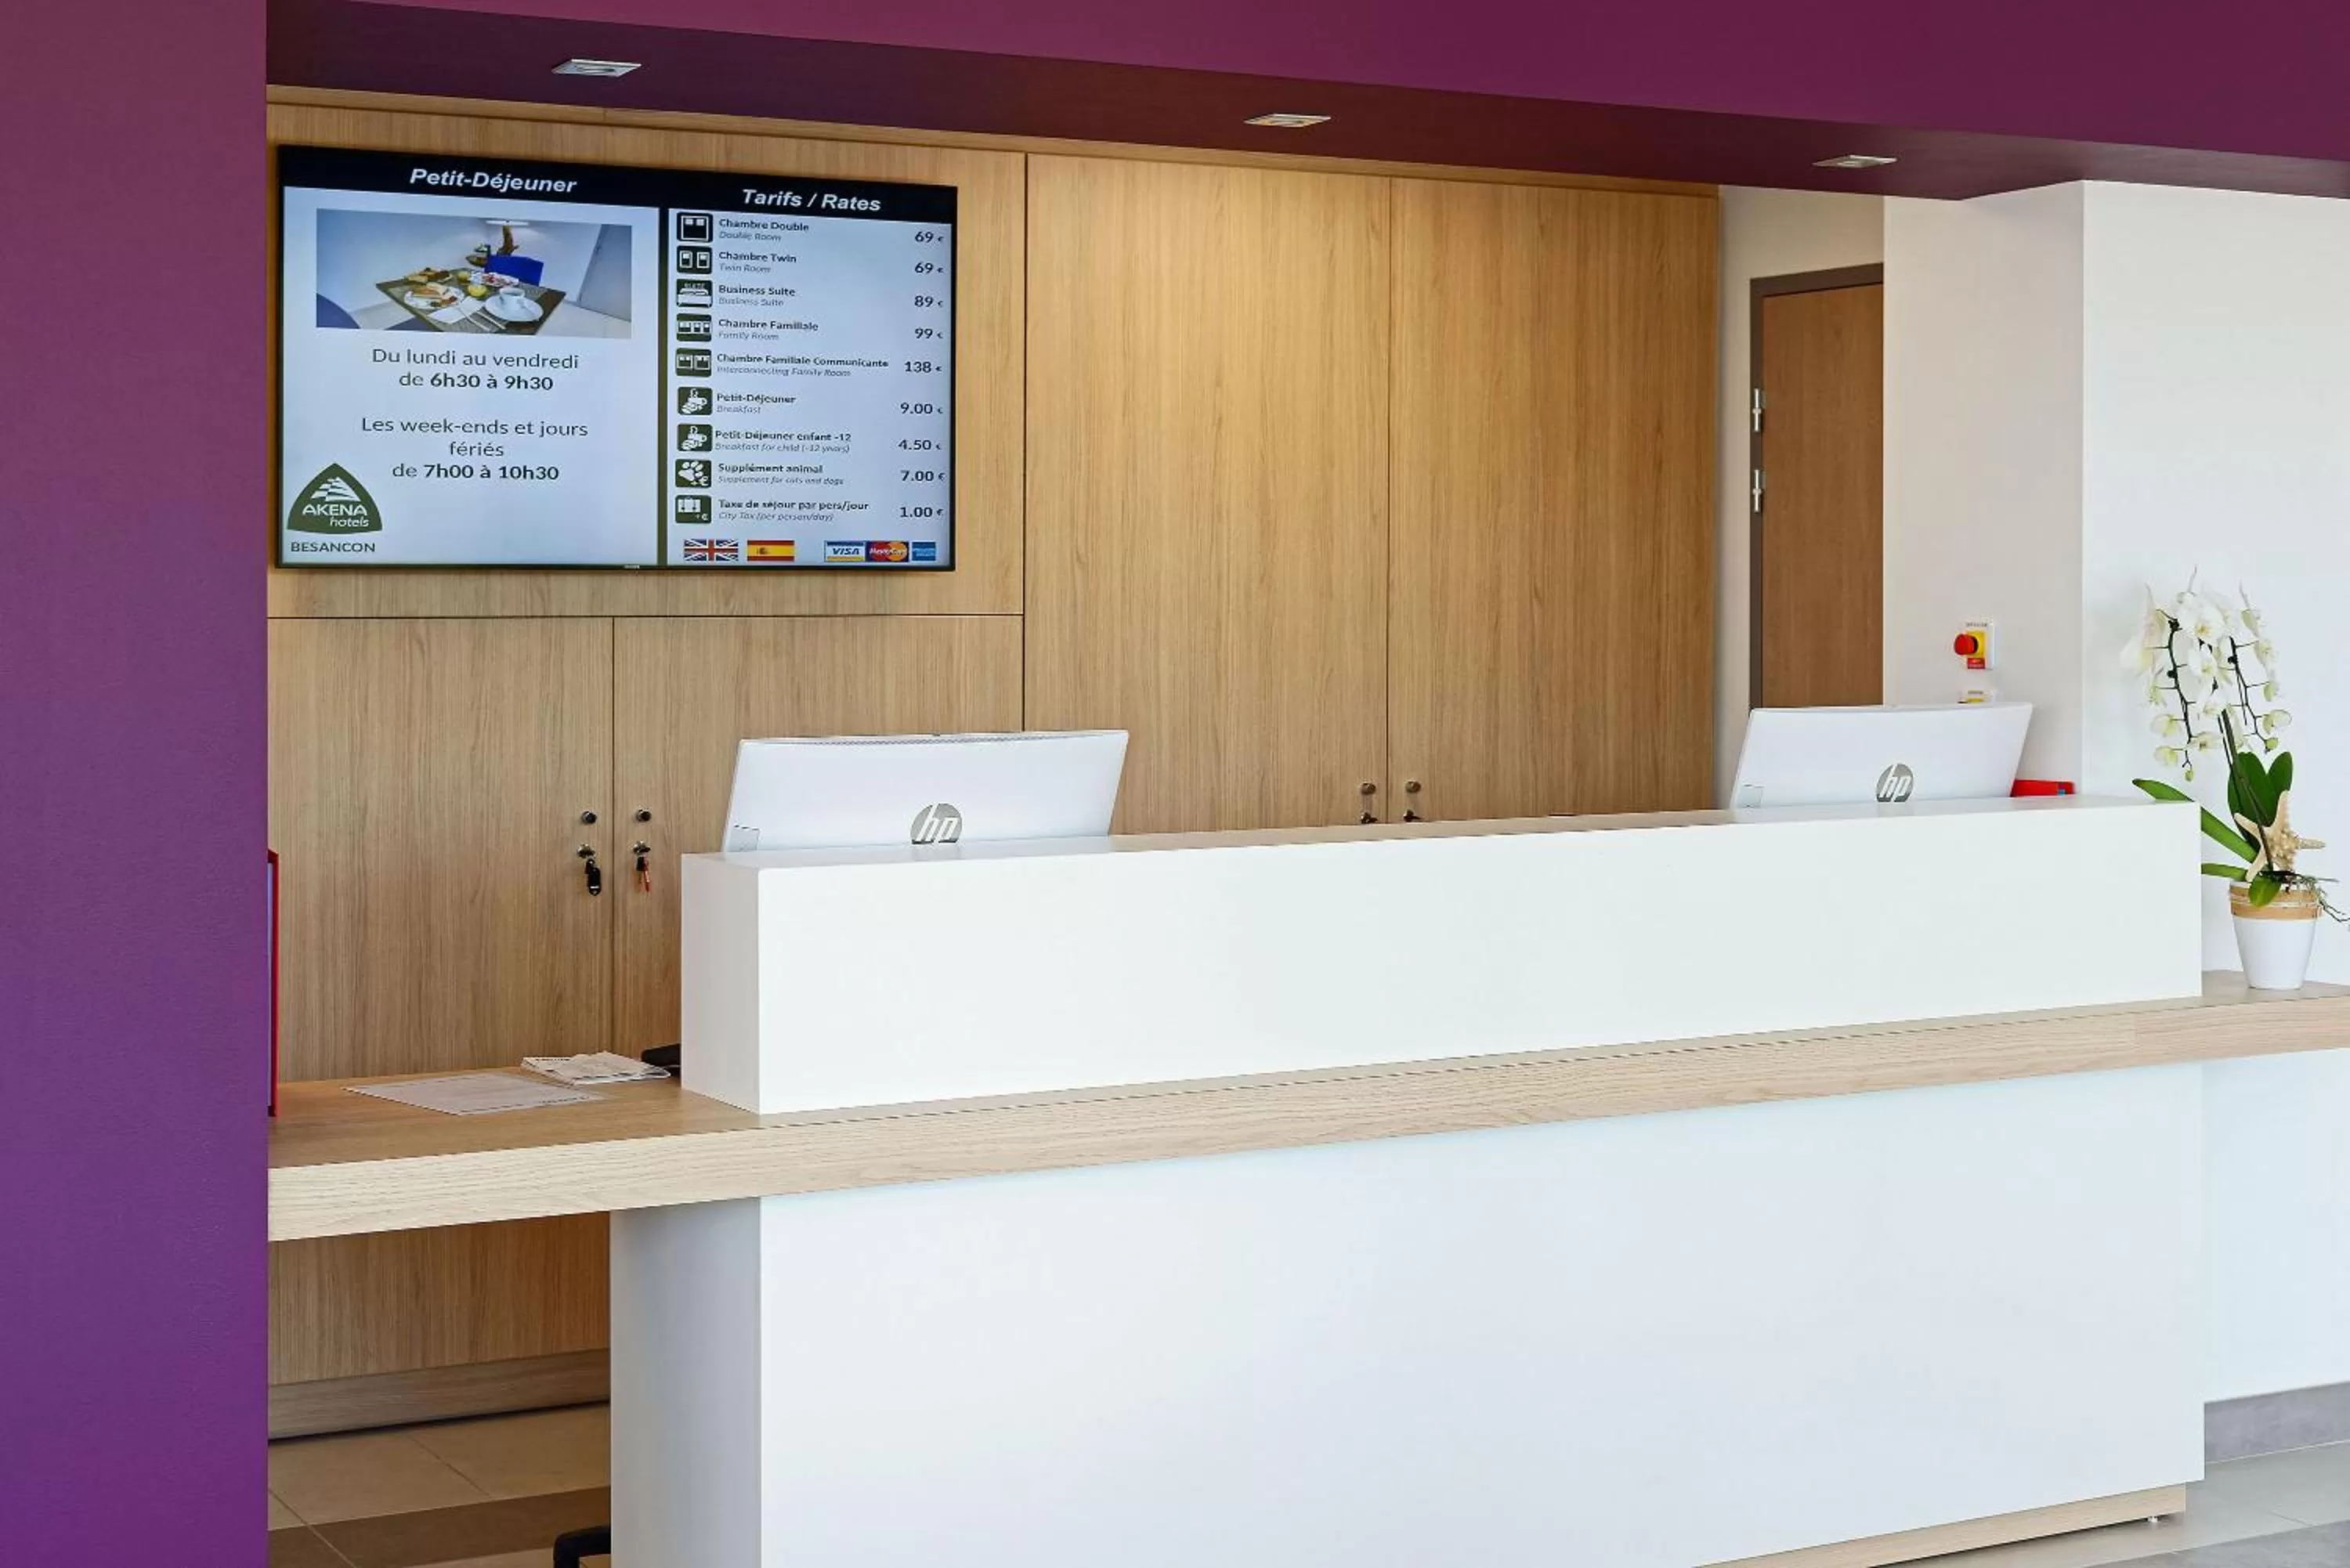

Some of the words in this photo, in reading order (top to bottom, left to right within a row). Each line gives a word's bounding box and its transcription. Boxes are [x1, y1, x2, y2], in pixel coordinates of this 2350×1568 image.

[410, 168, 577, 194] Petit-Déjeuner
[742, 189, 803, 207] Tarifs
[808, 193, 817, 207] /
[821, 193, 881, 211] Rates
[719, 219, 768, 229] Chambre
[770, 221, 809, 232] Double
[719, 231, 751, 240] Double
[754, 233, 781, 241] Room
[914, 232, 933, 243] 69
[719, 251, 768, 262] Chambre
[770, 254, 797, 263] Twin
[743, 265, 771, 273] Room
[914, 262, 933, 273] 69
[719, 285, 765, 295] Business
[768, 287, 796, 296] Suite
[719, 298, 757, 306] Business
[761, 298, 783, 306] Suite
[914, 296, 933, 307] 89
[718, 319, 768, 329] Chambre
[770, 321, 819, 331] Familiale
[751, 332, 779, 341] Room
[915, 328, 933, 339] 99
[372, 349, 400, 364] Du
[407, 349, 456, 366] lundi
[462, 352, 486, 367] au
[494, 352, 579, 369] vendredi
[717, 354, 763, 363] Chambre
[765, 356, 810, 365] Familiale
[814, 357, 888, 367] Communicante
[904, 361, 931, 373] 138
[399, 372, 424, 386] de
[430, 373, 480, 388] 6h30
[486, 374, 498, 389] à
[504, 374, 554, 391] 9h30
[717, 393, 797, 406] Petit-Déjeuner
[717, 405, 761, 414] Breakfast
[900, 403, 934, 414] 9.00
[362, 417, 395, 433] Les
[400, 418, 509, 435] week-ends
[515, 421, 534, 435] et
[539, 421, 588, 439] jours
[715, 430, 794, 442] Petit-Déjeuner
[797, 432, 831, 441] enfant
[834, 432, 851, 441] -12
[449, 441, 504, 457] fériés
[715, 443, 759, 453] Breakfast
[898, 439, 931, 450] 4.50
[392, 463, 418, 478] de
[423, 463, 474, 479] 7h00
[480, 464, 492, 479] à
[498, 464, 559, 481] 10h30
[718, 463, 783, 475] Supplément
[786, 464, 823, 474] animal
[901, 470, 935, 482] 7.00
[302, 504, 367, 516] AKENA
[719, 500, 743, 511] Taxe
[746, 500, 759, 511] de
[762, 500, 796, 512] séjour
[799, 502, 816, 512] par
[819, 501, 869, 513] pers/jour
[900, 507, 932, 518] 1.00
[330, 516, 370, 527] hotels
[291, 541, 376, 553] BESANCON
[833, 547, 860, 555] VISA
[1878, 764, 1912, 802] hp
[914, 804, 960, 844] hp
